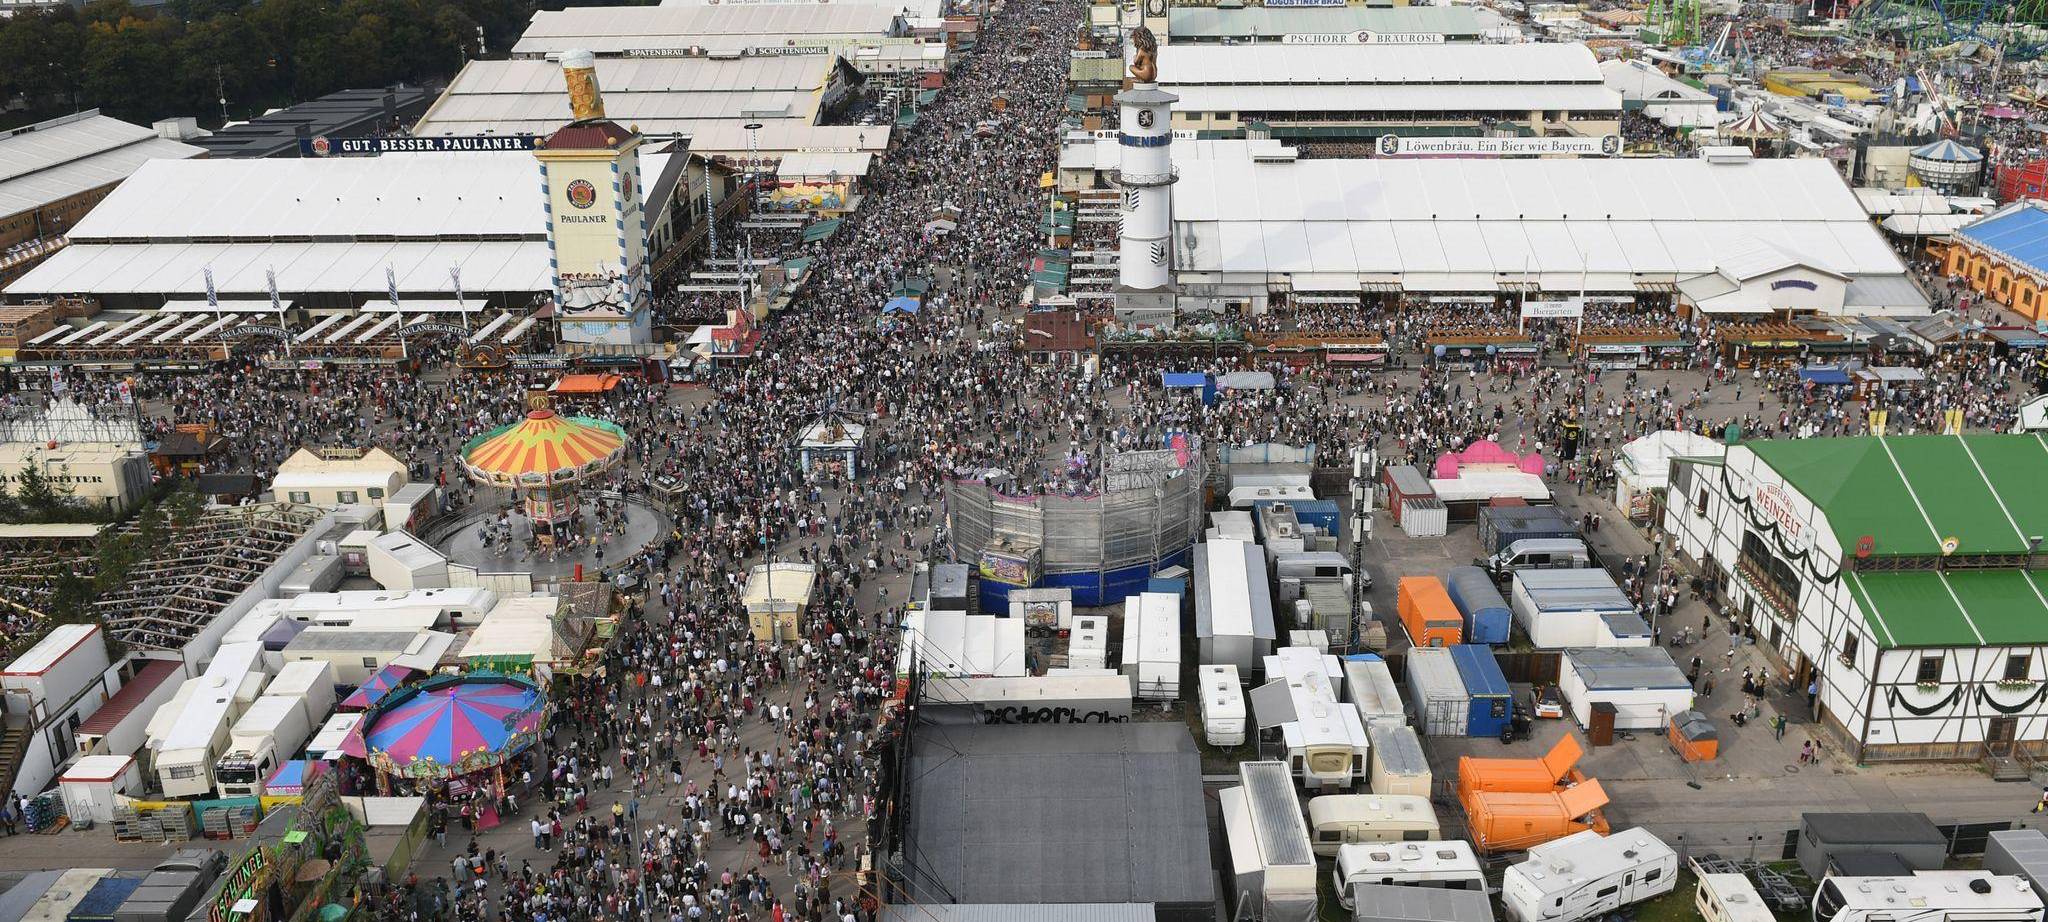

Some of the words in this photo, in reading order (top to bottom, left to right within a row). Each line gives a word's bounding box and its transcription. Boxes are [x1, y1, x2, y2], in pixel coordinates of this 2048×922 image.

[1291, 35, 1348, 43] PSCHORR
[759, 47, 827, 55] SCHOTTENHAMEL
[342, 139, 377, 152] GUT,
[380, 138, 440, 151] BESSER,
[443, 138, 528, 150] PAULANER.
[1405, 139, 1474, 152] Löwenbräu.
[1477, 140, 1497, 151] Ein
[1501, 140, 1524, 151] Bier
[1528, 141, 1548, 151] wie
[1551, 140, 1595, 154] Bayern.
[561, 214, 607, 224] PAULANER
[218, 325, 290, 340] PAULANERGARTEN
[398, 324, 469, 337] PAULANERGARTEN
[1755, 486, 1802, 538] WEINZELT
